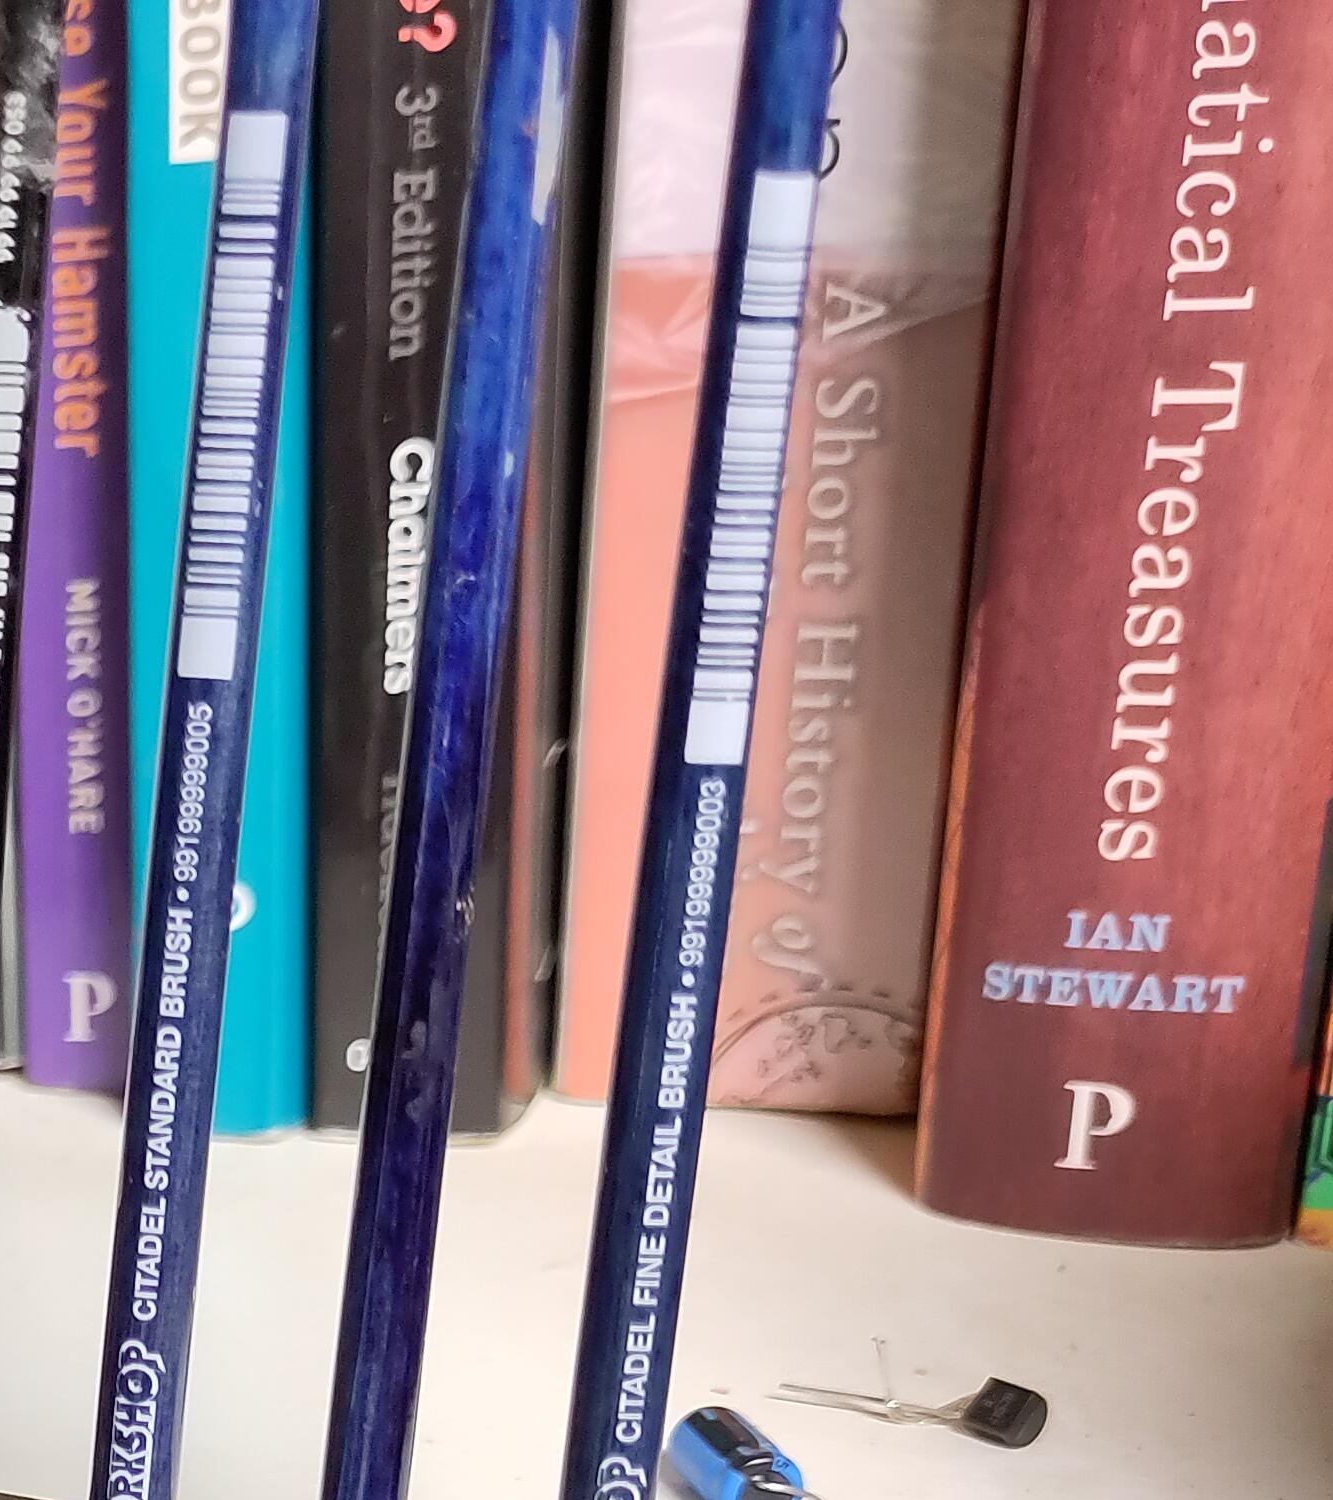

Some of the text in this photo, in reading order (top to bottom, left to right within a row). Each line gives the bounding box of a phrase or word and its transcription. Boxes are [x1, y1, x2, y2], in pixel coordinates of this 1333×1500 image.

[53, 78, 109, 206] Your
[389, 167, 435, 362] Edition
[819, 279, 887, 343] A
[49, 227, 110, 457] Hamster
[801, 377, 882, 587] Short
[1097, 0, 1274, 863] atical Treasures
[383, 437, 434, 696] Chalmers
[65, 577, 102, 691] NICK
[758, 622, 859, 894] History
[159, 906, 194, 1021] BRUSH
[981, 961, 1247, 1015] STEWART
[1063, 908, 1173, 953] IAN
[62, 968, 119, 1044] P
[658, 994, 699, 1110] BRUSH
[144, 1025, 183, 1190] STANDARD
[1052, 1078, 1137, 1172] P
[643, 1118, 684, 1229] DETAIL
[132, 1195, 169, 1322] CITADEL
[632, 1230, 668, 1307] FINE
[614, 1307, 657, 1445] CITADEL
